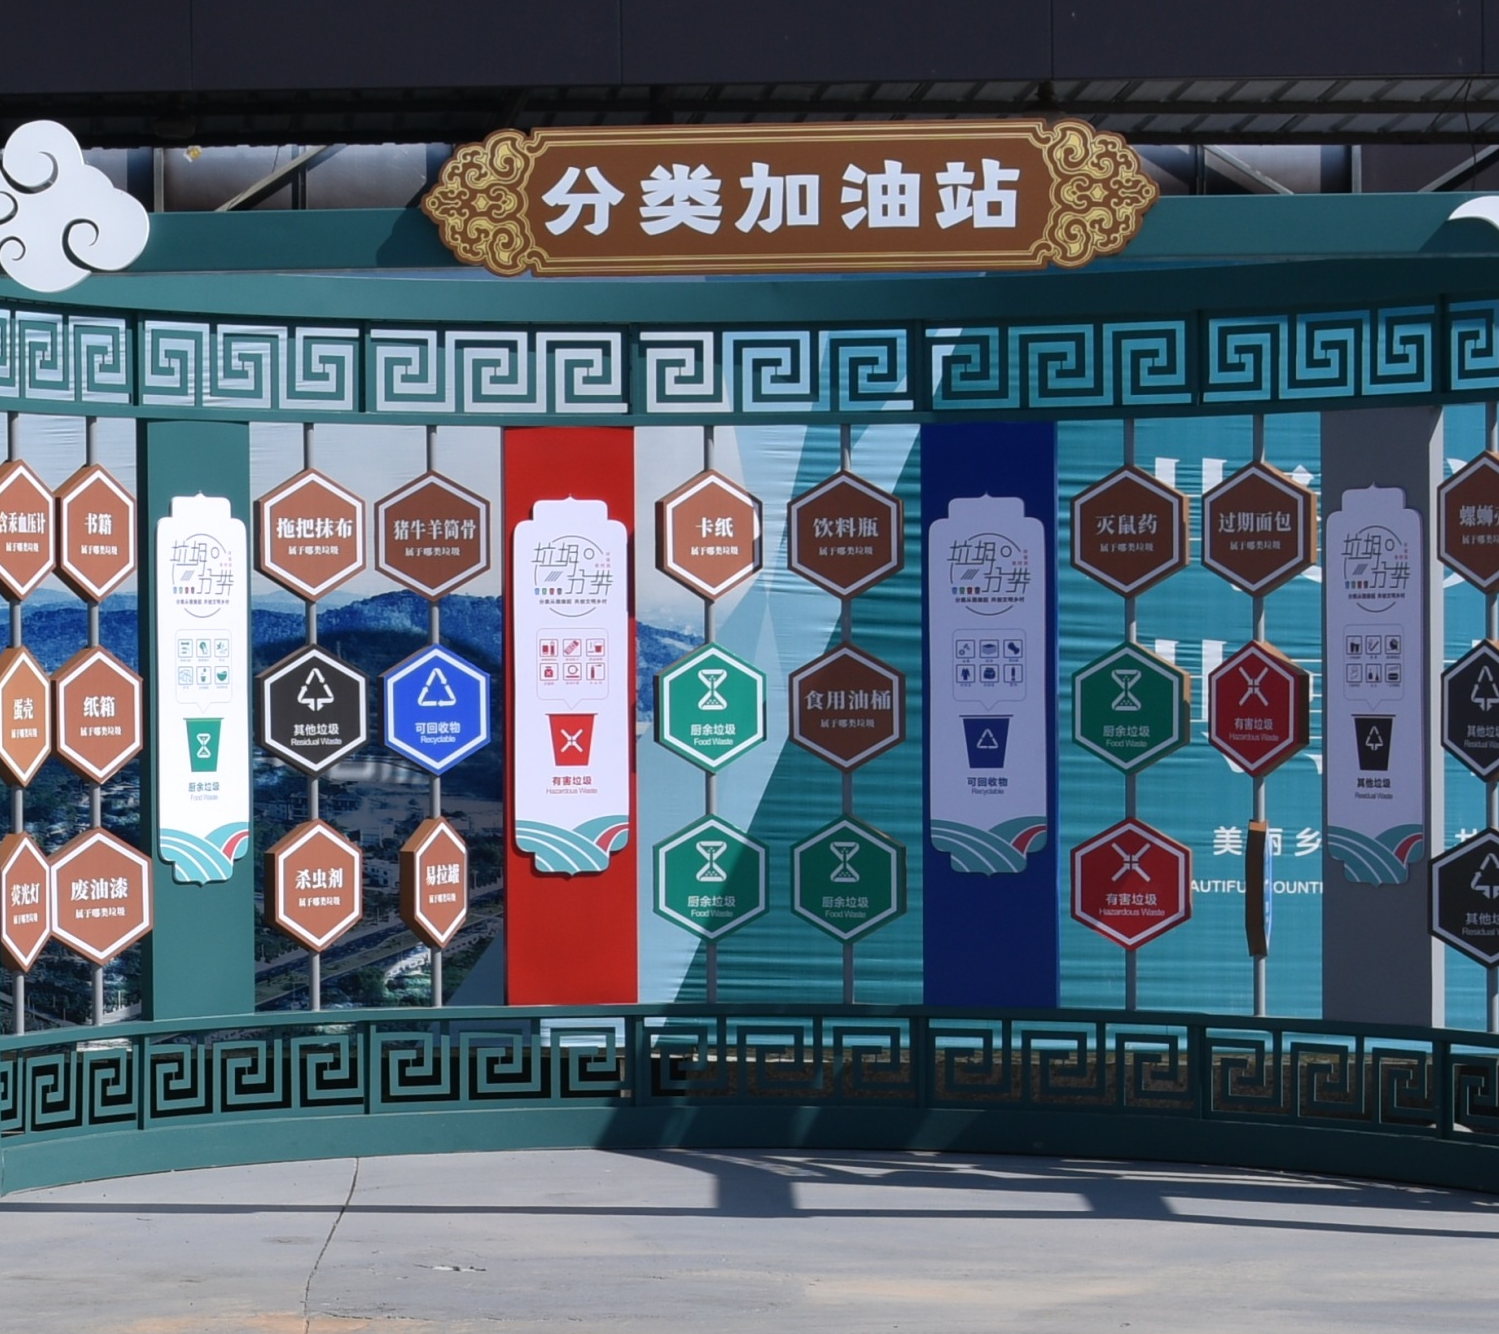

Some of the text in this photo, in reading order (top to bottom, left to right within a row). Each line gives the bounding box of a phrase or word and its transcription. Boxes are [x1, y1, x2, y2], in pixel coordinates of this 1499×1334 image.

[540, 158, 1021, 237] 分类加油站
[84, 512, 112, 535] 书籍
[276, 517, 353, 539] 拖把抹布
[393, 519, 476, 540] 猪牛羊筒骨
[695, 517, 733, 538] 卡纸
[812, 517, 879, 538] 饮料瓶
[1095, 514, 1158, 536] 灭鼠药
[1218, 511, 1292, 533] 过期面包
[13, 698, 34, 720] 蛋壳
[83, 696, 116, 718] 纸箱
[804, 689, 892, 711] 食用油桶
[293, 724, 340, 736] 其他垃圾
[414, 722, 461, 734] 可回收物
[690, 724, 736, 736] 厨余垃圾
[1102, 725, 1151, 738] 厨余垃圾
[1234, 718, 1274, 731] 有害垃圾
[188, 782, 220, 793] 厨余垃圾
[552, 776, 592, 786] 有害垃圾
[967, 777, 1008, 787] 可回收物
[1356, 778, 1391, 788] 其他垃圾
[295, 868, 343, 890] 杀虫剂
[425, 864, 461, 885] 易拉罐
[11, 882, 40, 907] 荧光灯
[71, 877, 129, 901] 废油漆
[1105, 893, 1158, 906] 有害垃圾
[687, 895, 736, 907] 厨余垃圾
[822, 896, 869, 908] 厨余垃圾
